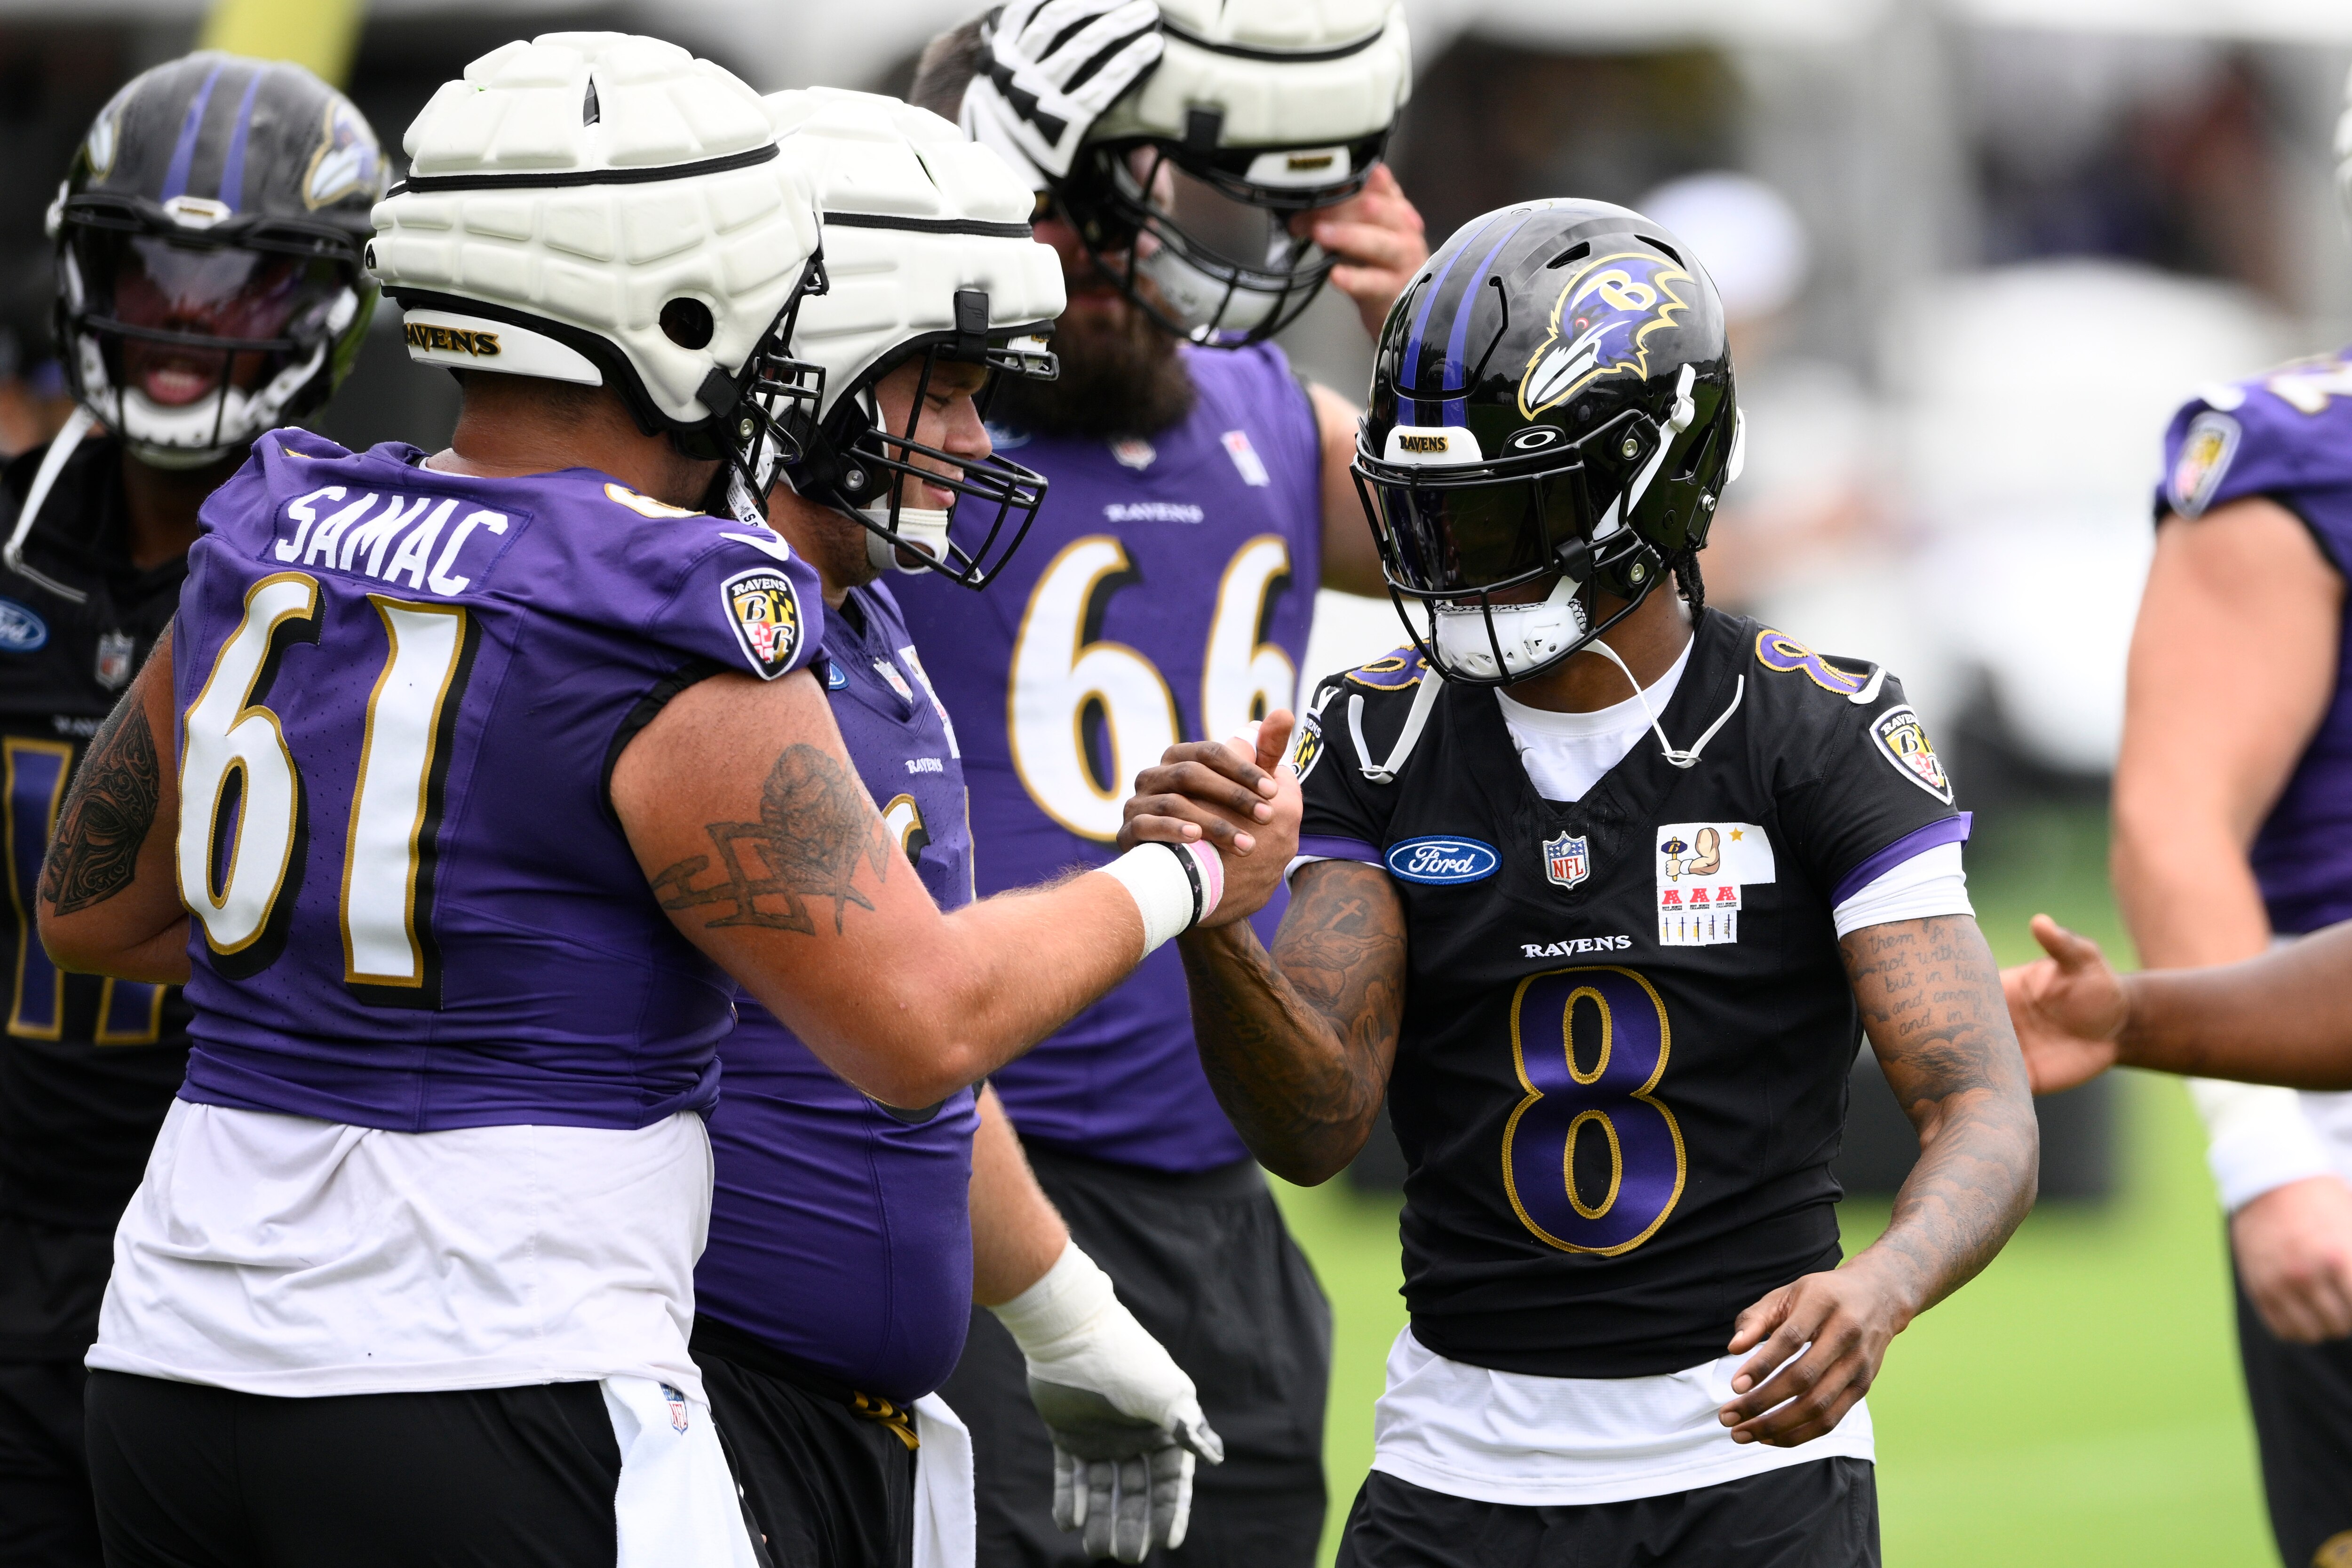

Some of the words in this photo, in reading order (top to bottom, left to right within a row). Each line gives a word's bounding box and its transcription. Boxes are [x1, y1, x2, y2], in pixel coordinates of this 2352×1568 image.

[1398, 434, 1449, 453] RAVENS
[1103, 503, 1204, 523] RAVENS
[275, 485, 509, 596] SAMAC
[731, 578, 787, 596] RAVENS
[1007, 534, 1297, 847] 66
[905, 757, 943, 773] RAVENS
[176, 571, 483, 1010] 61
[1408, 847, 1475, 874] Ford
[1552, 857, 1584, 879] NFL
[1521, 935, 1633, 958] RAVENS
[1877, 951, 1907, 973] not
[1885, 973, 1916, 993] but
[1926, 971, 1943, 983] in
[1893, 990, 1924, 1015] and
[1899, 1008, 1932, 1036] and
[1947, 1009, 1963, 1022] in
[1502, 965, 1687, 1257] 8
